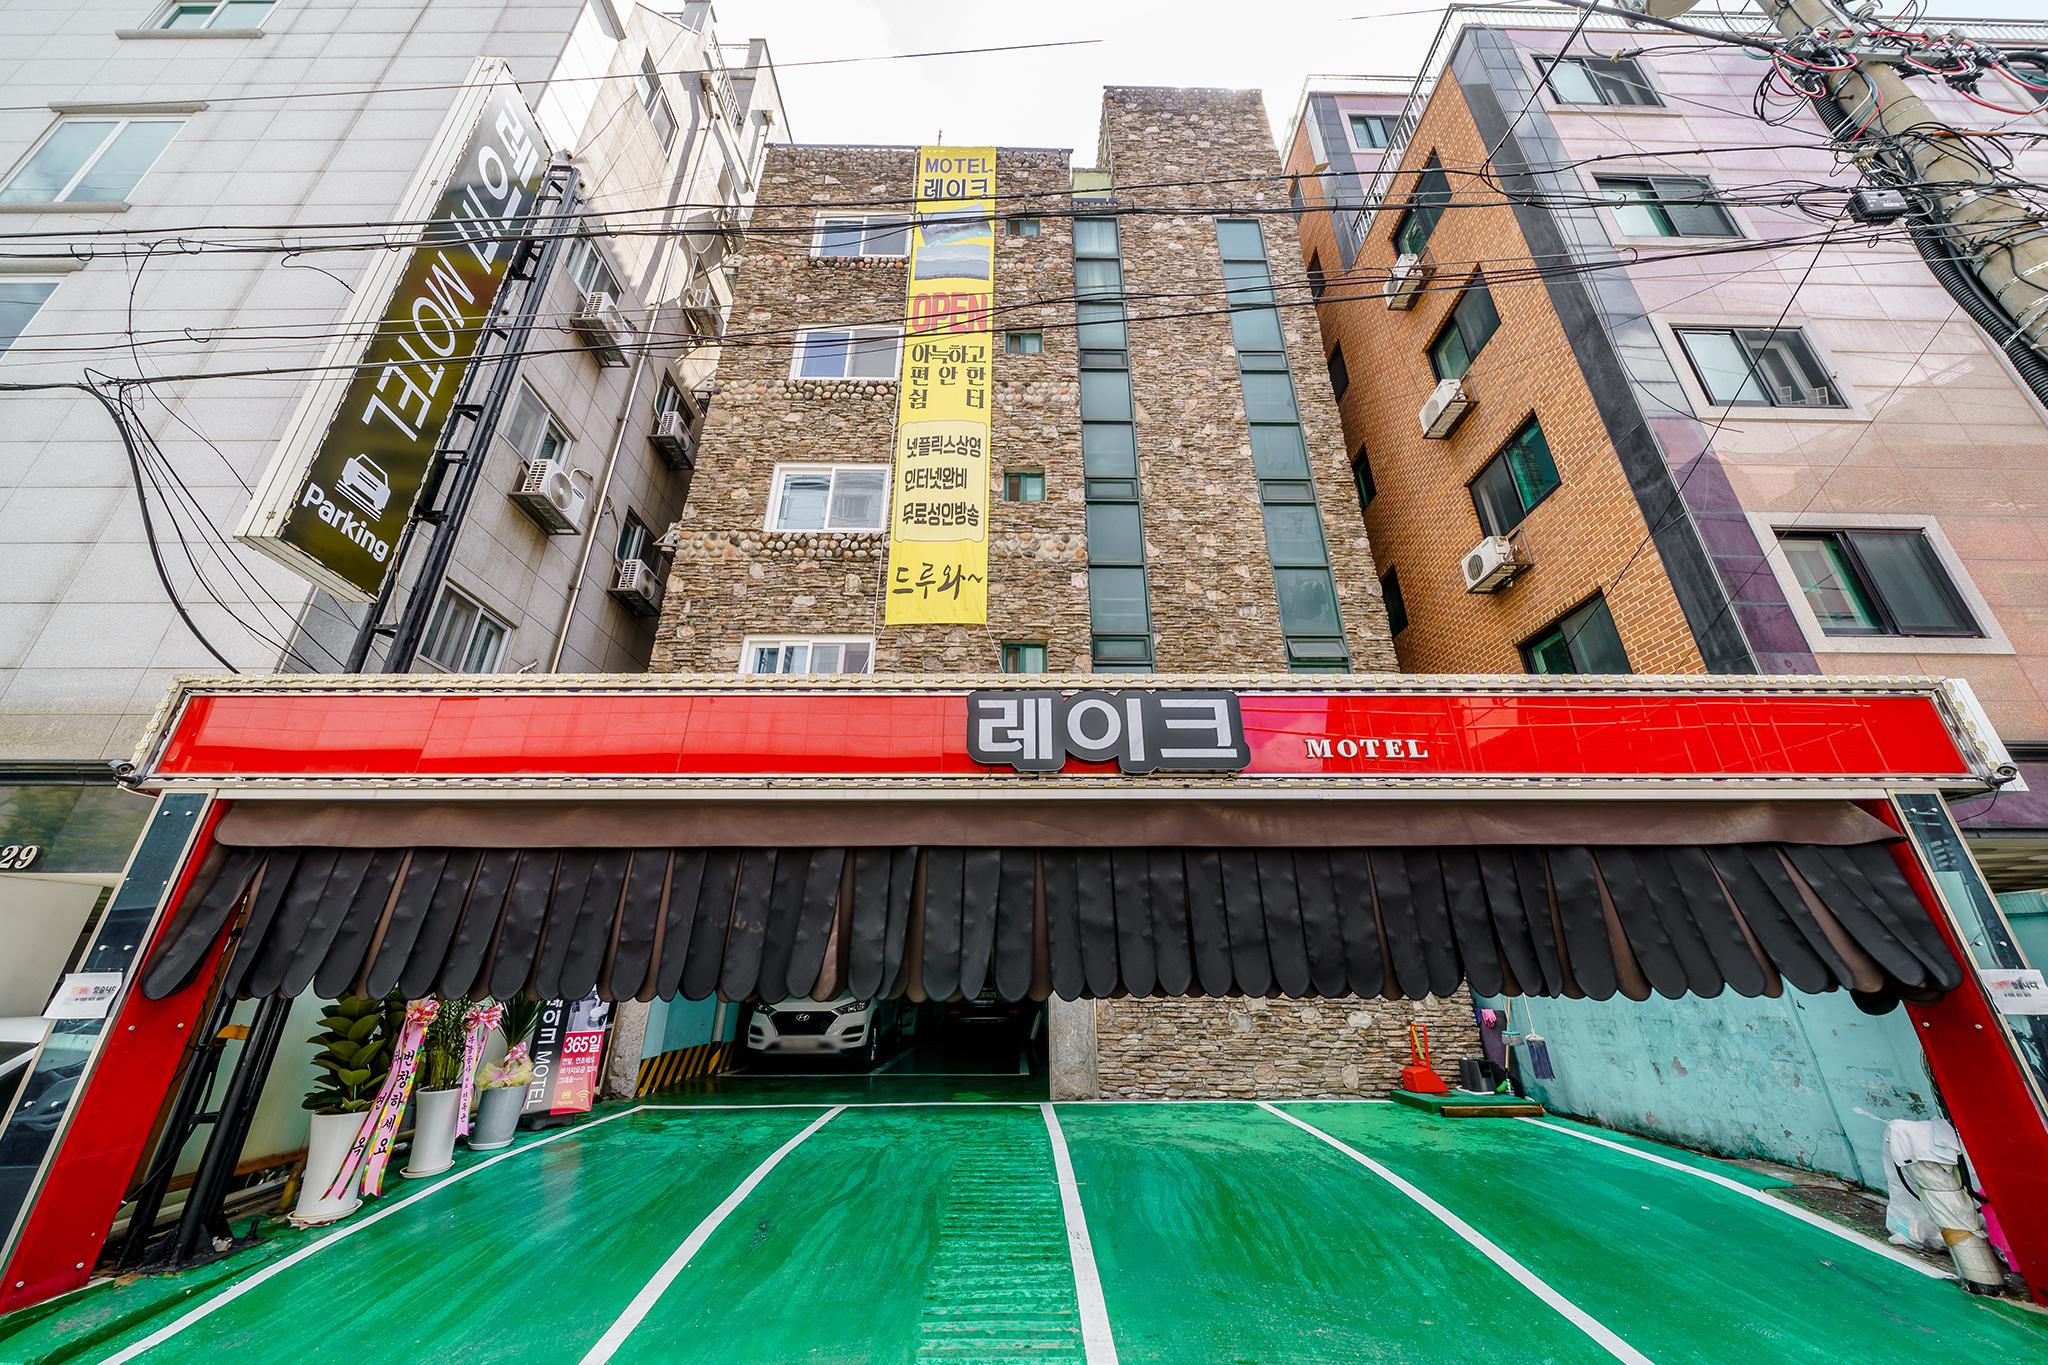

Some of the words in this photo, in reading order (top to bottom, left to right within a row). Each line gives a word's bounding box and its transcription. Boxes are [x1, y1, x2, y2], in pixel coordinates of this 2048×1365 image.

[925, 157, 993, 174] MOTEL
[450, 100, 538, 275] 레이크
[923, 178, 989, 200] 레이크
[911, 291, 988, 334] OPEN
[362, 251, 475, 442] MOTEL
[911, 344, 986, 365] 아늑하고
[906, 435, 982, 458] 넷플릭스상영
[904, 466, 968, 492] 인터넷완비
[301, 481, 389, 563] Parking
[902, 501, 980, 527] 무료성인방송
[978, 697, 1238, 762] 레이크
[1304, 738, 1429, 760] MOTEL
[564, 1034, 602, 1054] 365일
[526, 1051, 552, 1110] MOTEL
